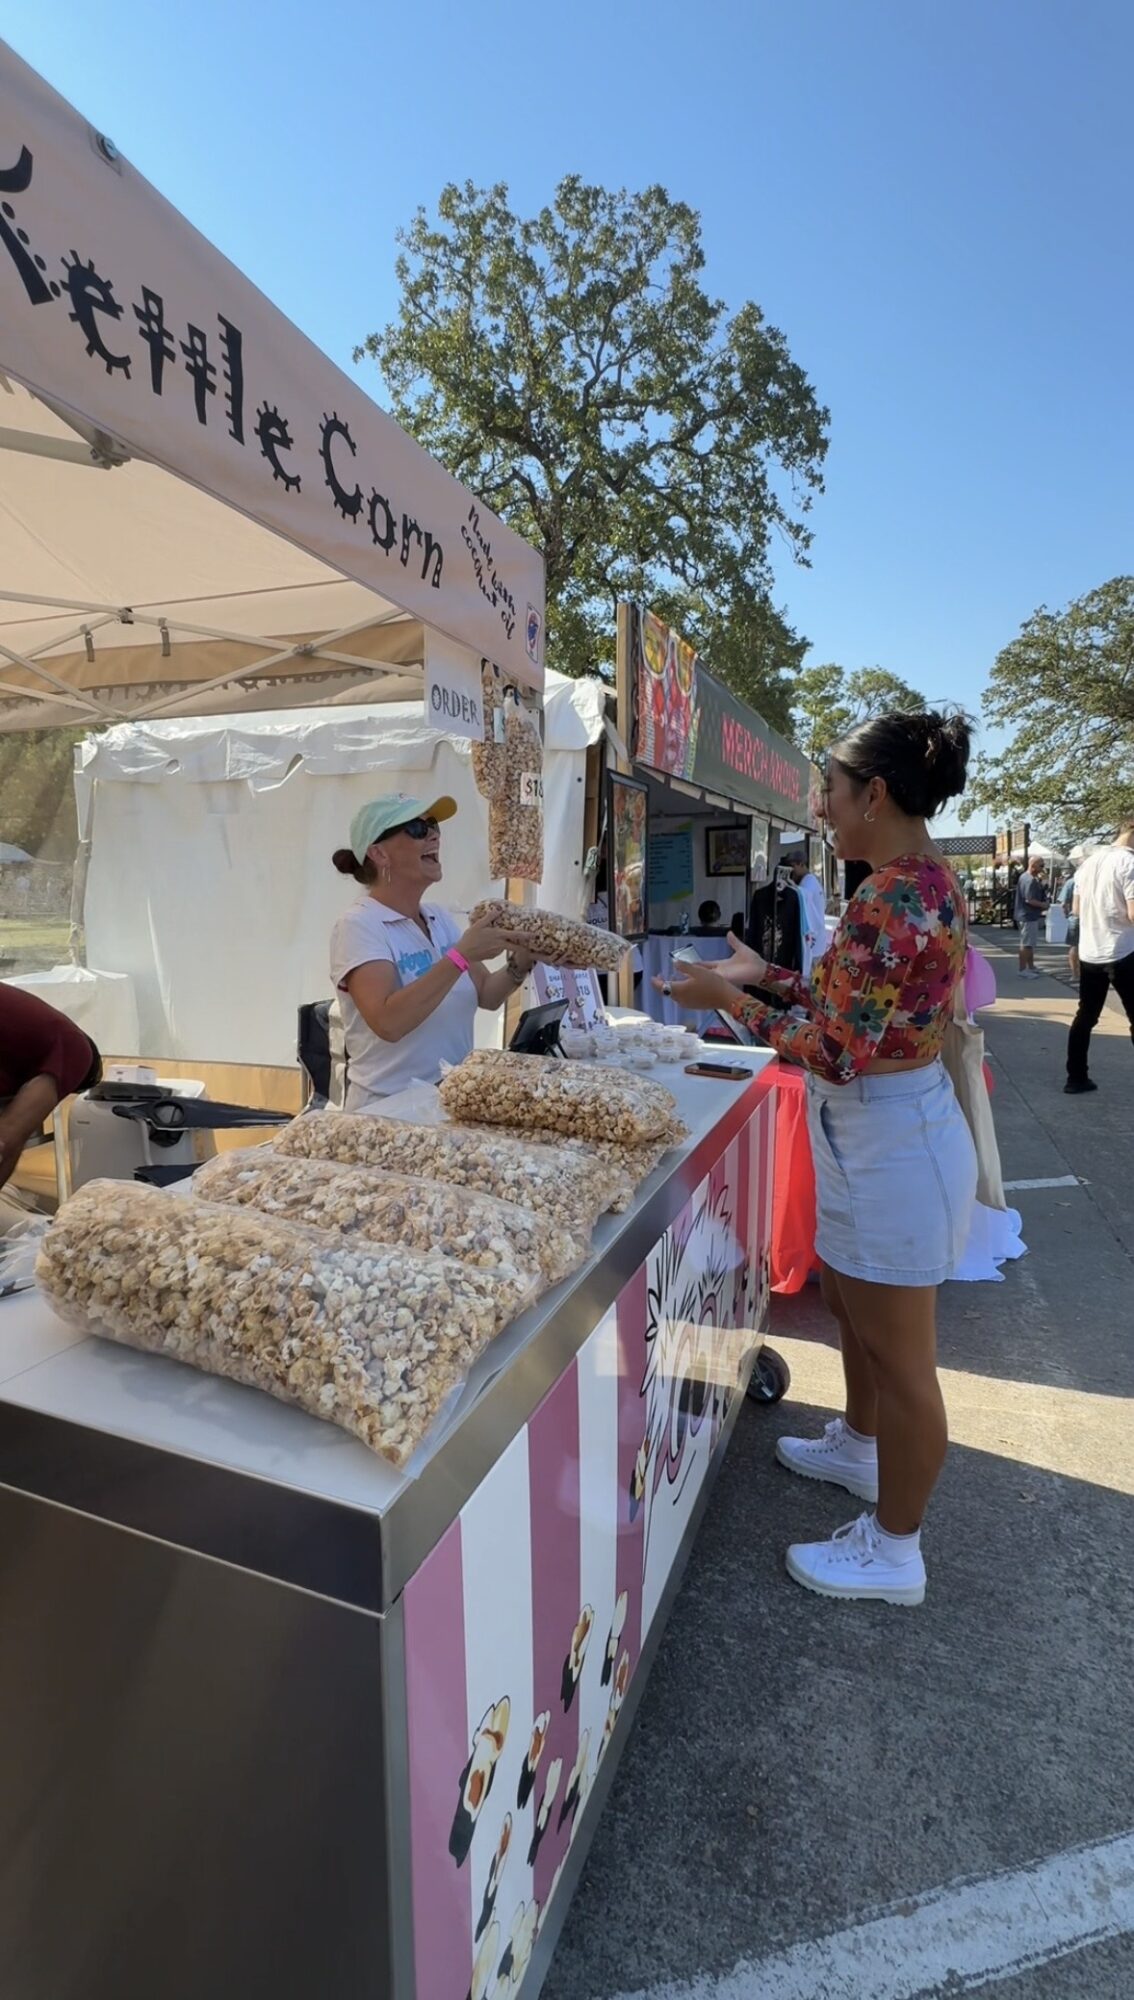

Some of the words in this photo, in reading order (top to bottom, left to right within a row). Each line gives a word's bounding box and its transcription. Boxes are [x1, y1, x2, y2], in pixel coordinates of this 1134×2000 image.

[318, 411, 443, 589] Corn
[460, 525, 498, 608] coconut
[501, 610, 516, 640] oil
[468, 504, 494, 571] Made
[491, 570, 516, 616] with
[431, 684, 480, 726] ORDER
